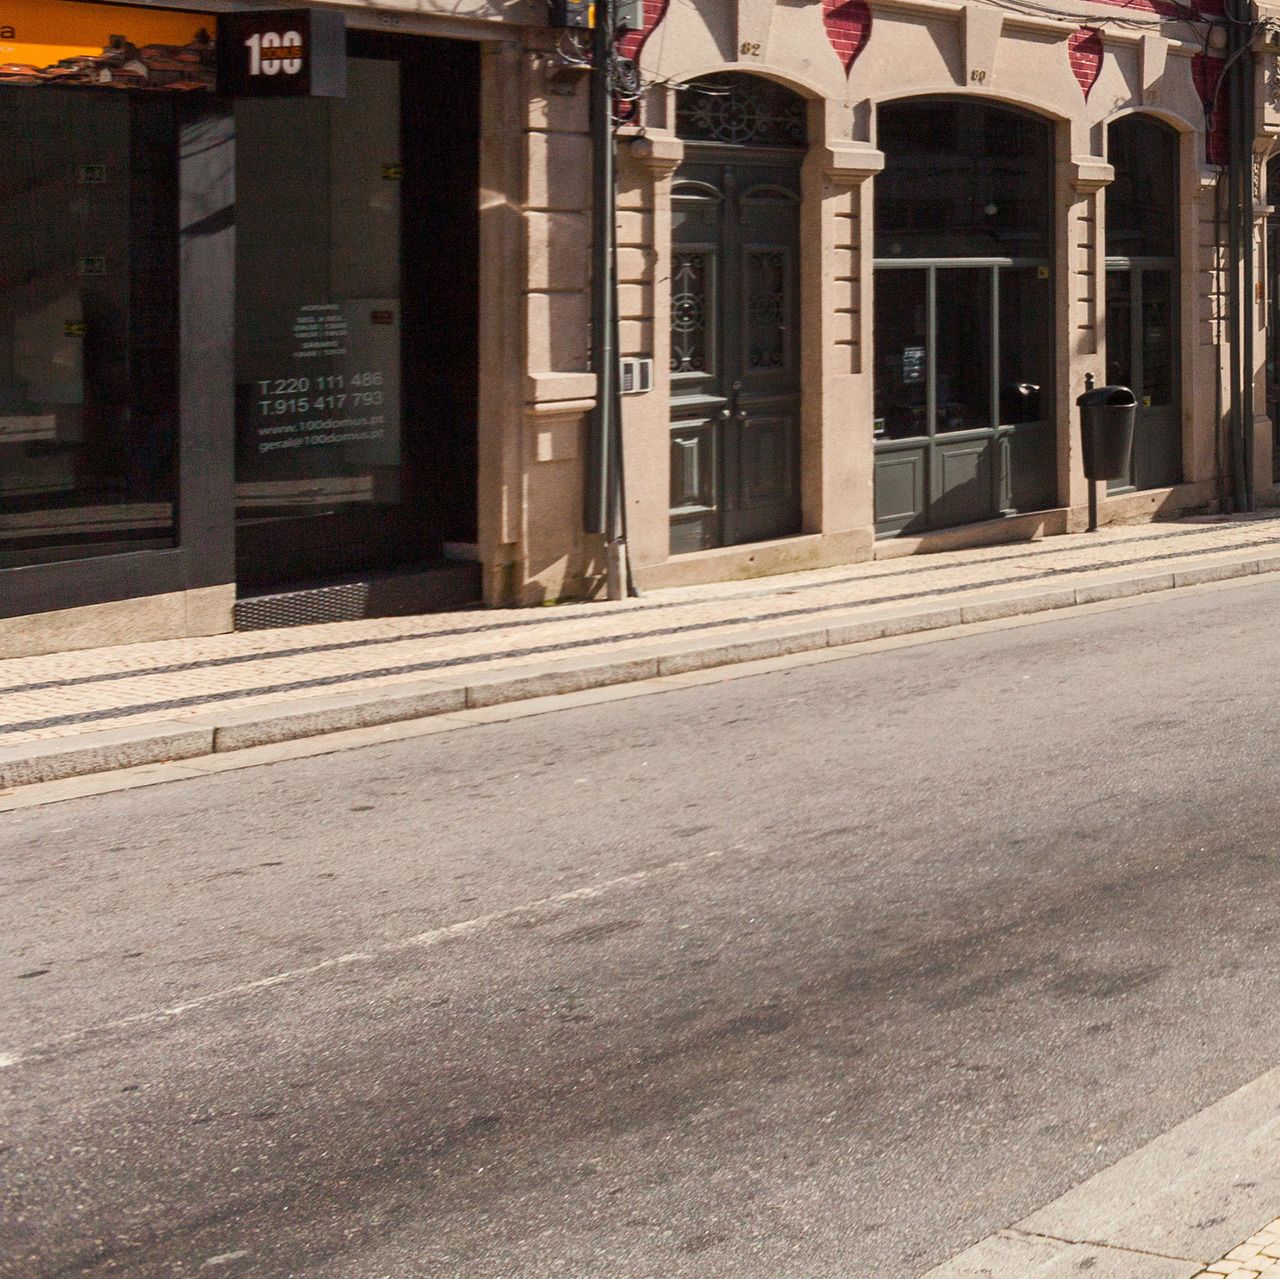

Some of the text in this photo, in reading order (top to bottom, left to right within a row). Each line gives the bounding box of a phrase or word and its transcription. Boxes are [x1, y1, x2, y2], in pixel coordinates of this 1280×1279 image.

[244, 30, 303, 76] 100
[316, 375, 345, 390] 111
[313, 394, 347, 411] 417
